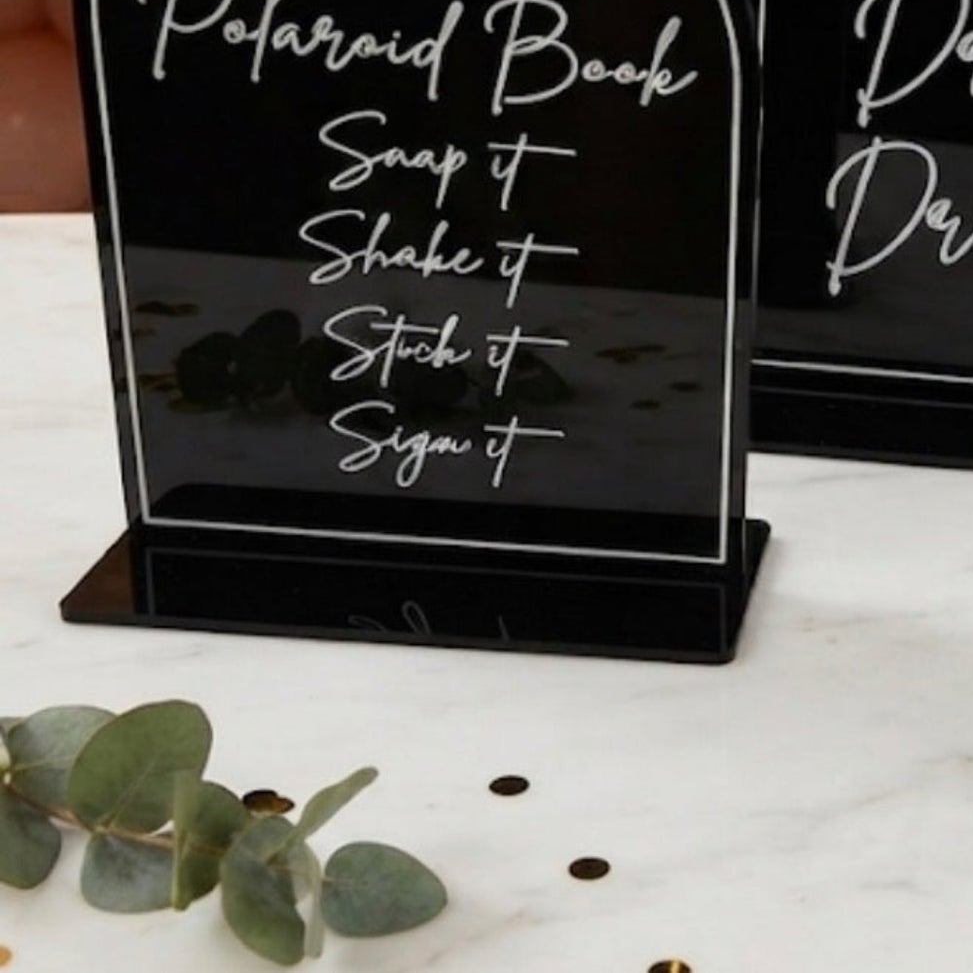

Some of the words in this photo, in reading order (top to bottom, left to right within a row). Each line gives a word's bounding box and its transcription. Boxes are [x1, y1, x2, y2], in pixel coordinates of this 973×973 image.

[488, 133, 576, 211] it
[298, 209, 484, 285] Shake
[496, 233, 579, 309] it
[486, 325, 569, 396] it
[329, 400, 472, 488] Sign
[484, 416, 565, 488] it
